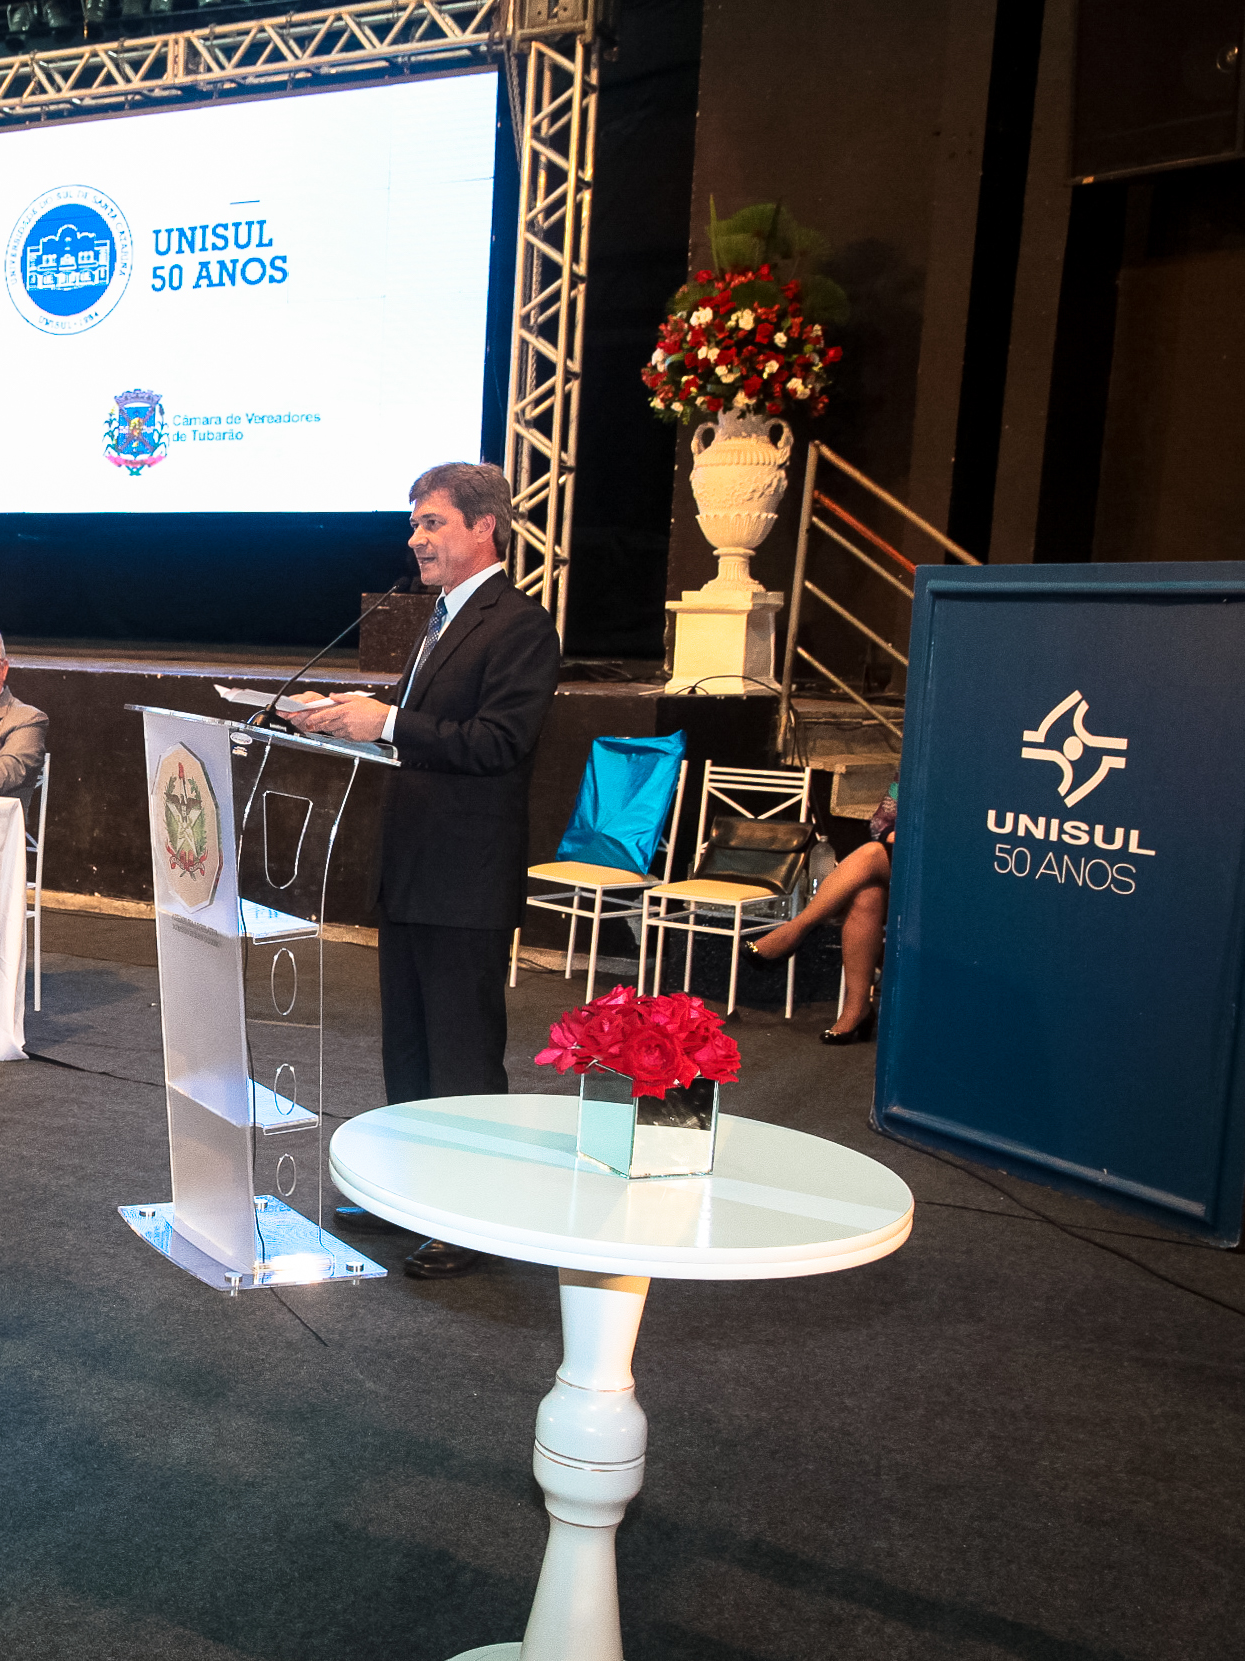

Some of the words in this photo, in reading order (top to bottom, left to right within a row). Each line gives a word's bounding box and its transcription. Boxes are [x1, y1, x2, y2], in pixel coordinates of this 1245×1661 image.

[153, 220, 273, 256] UNISUL
[151, 264, 183, 292] 50
[193, 255, 288, 289] ANOS
[172, 414, 222, 426] Câmara
[226, 413, 242, 425] de
[245, 412, 322, 424] Vereadores
[172, 430, 187, 442] de
[192, 429, 244, 441] Tubarão
[986, 809, 1156, 856] UNISUL
[994, 844, 1031, 877] 50
[1035, 852, 1136, 895] ANOS
